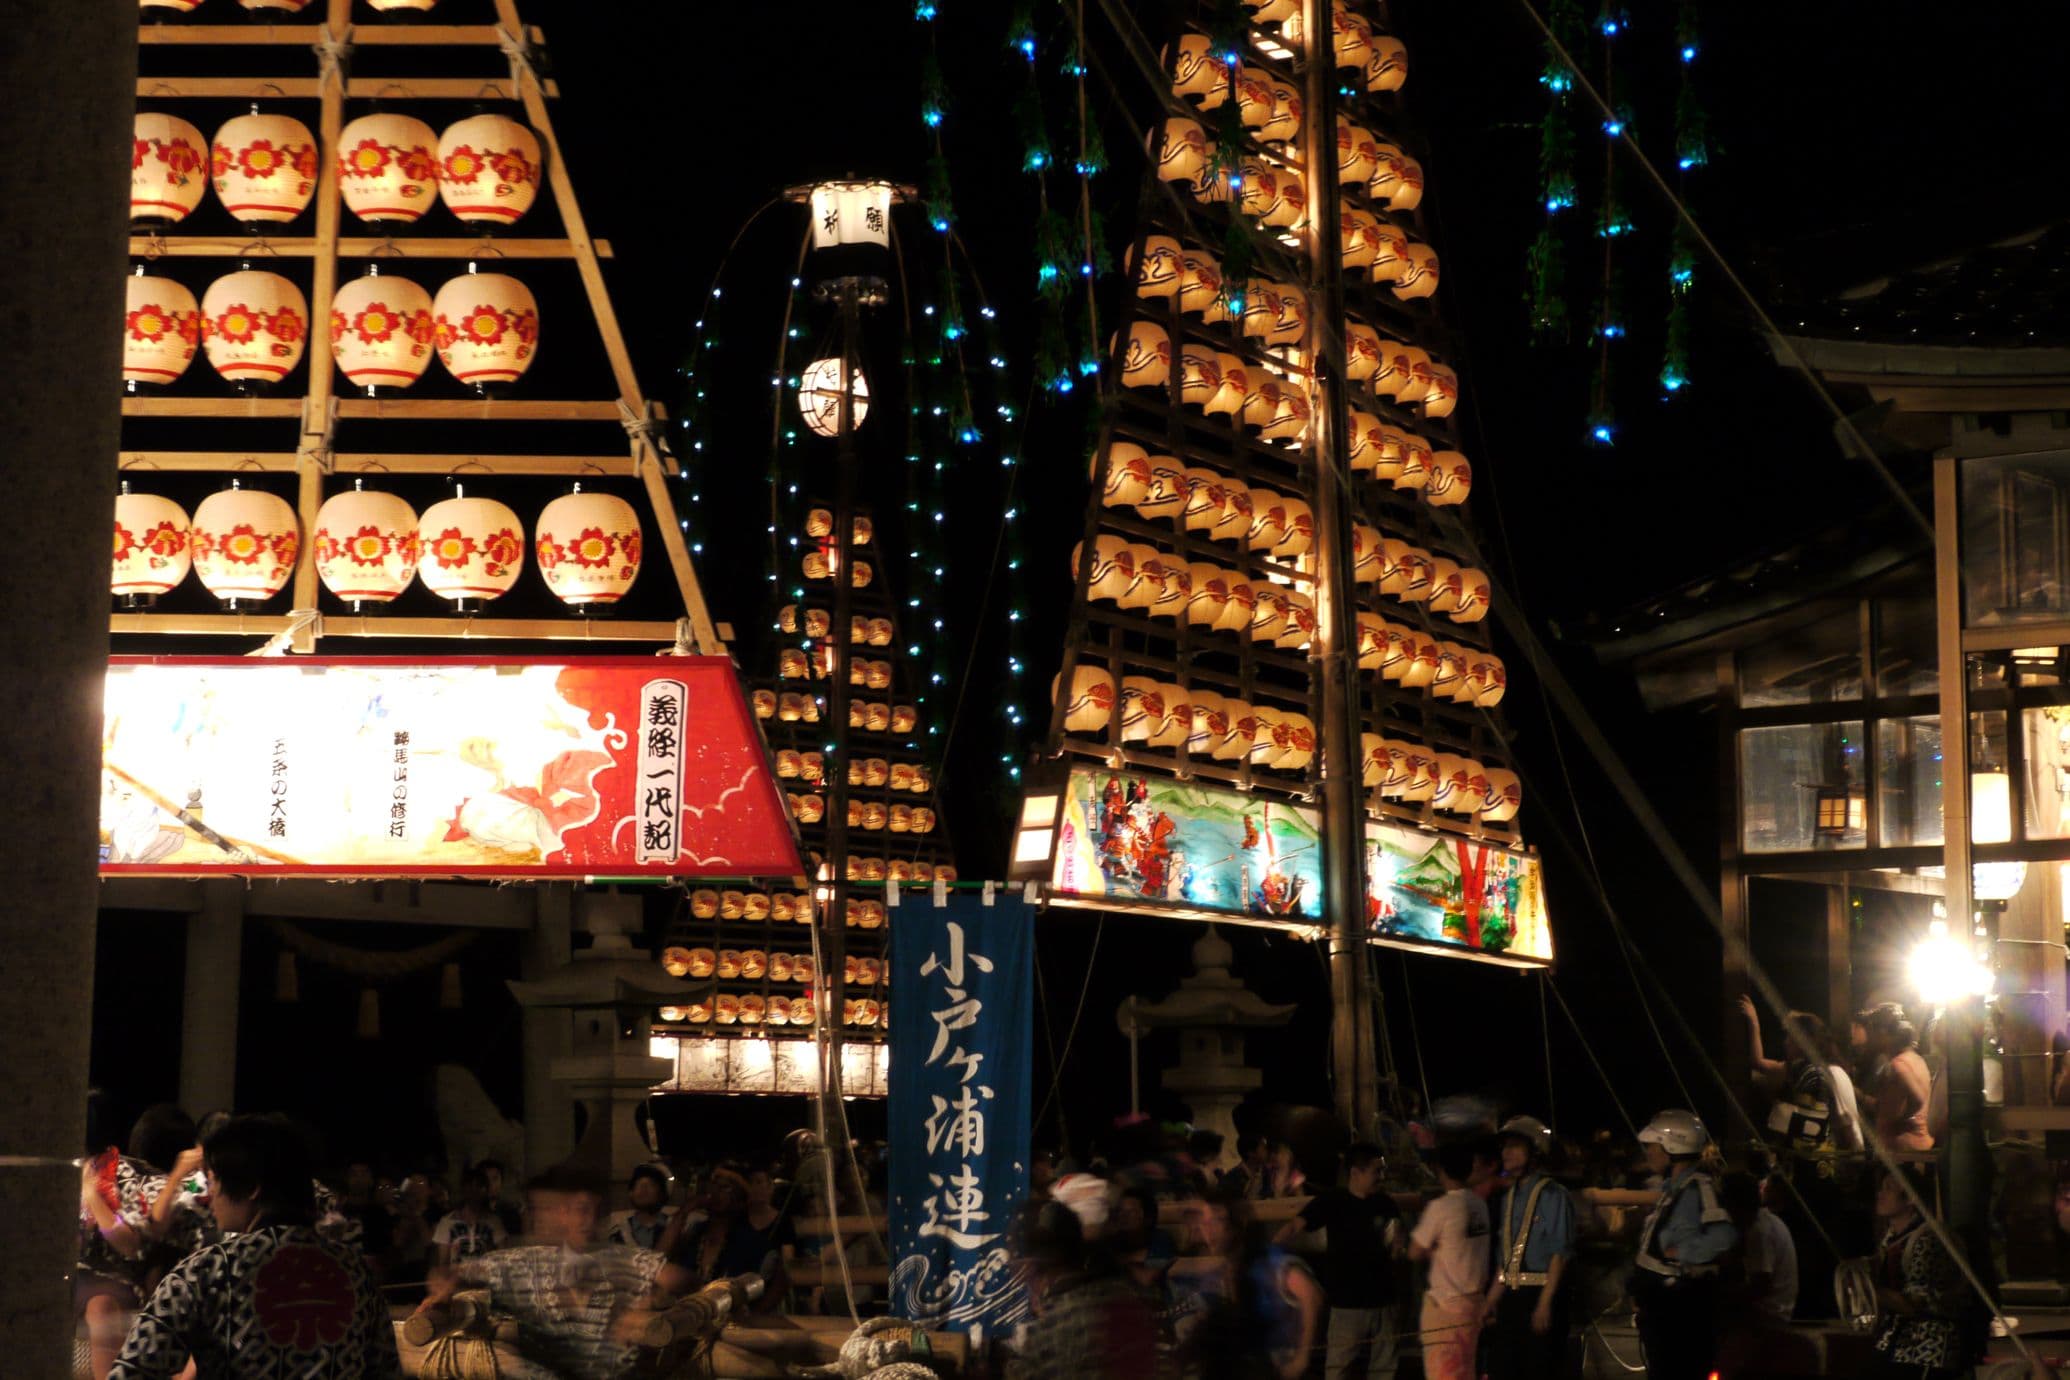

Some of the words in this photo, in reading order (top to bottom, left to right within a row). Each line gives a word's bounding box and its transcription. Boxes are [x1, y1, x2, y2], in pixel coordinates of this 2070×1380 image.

[390, 731, 409, 837] 鞍馬山の修行
[645, 695, 677, 850] 義経一代記
